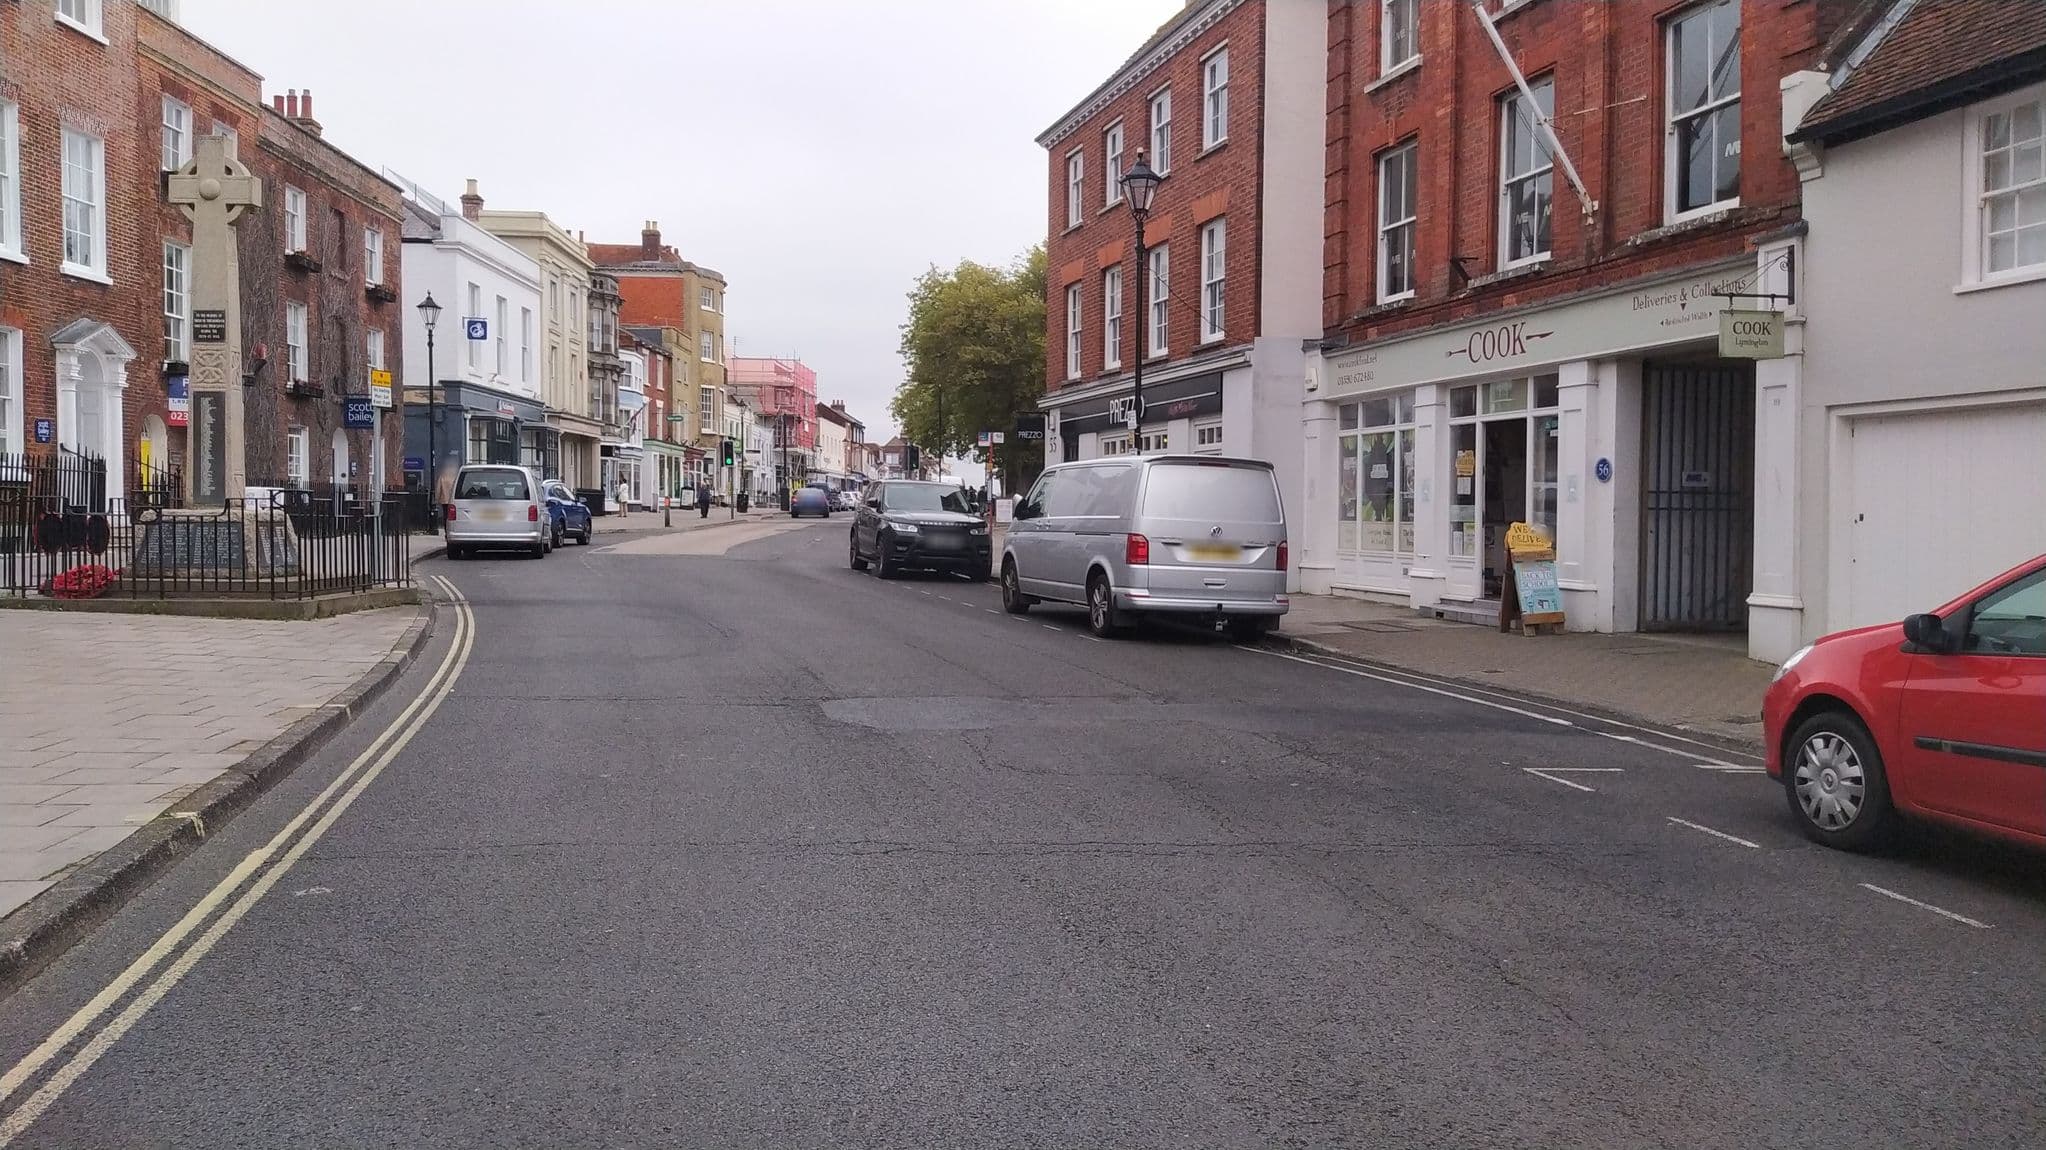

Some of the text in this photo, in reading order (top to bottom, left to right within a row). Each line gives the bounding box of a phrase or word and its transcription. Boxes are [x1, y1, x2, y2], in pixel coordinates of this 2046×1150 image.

[1632, 278, 1746, 311] Deliveries & Collections
[1732, 321, 1772, 335] COOK
[1468, 322, 1526, 363] COOK
[348, 402, 374, 411] scott
[348, 411, 374, 423] bailey
[1017, 431, 1043, 439] PREZZO
[1598, 463, 1609, 476] 56
[1512, 525, 1528, 534] WE
[1511, 534, 1547, 544] DELIVE
